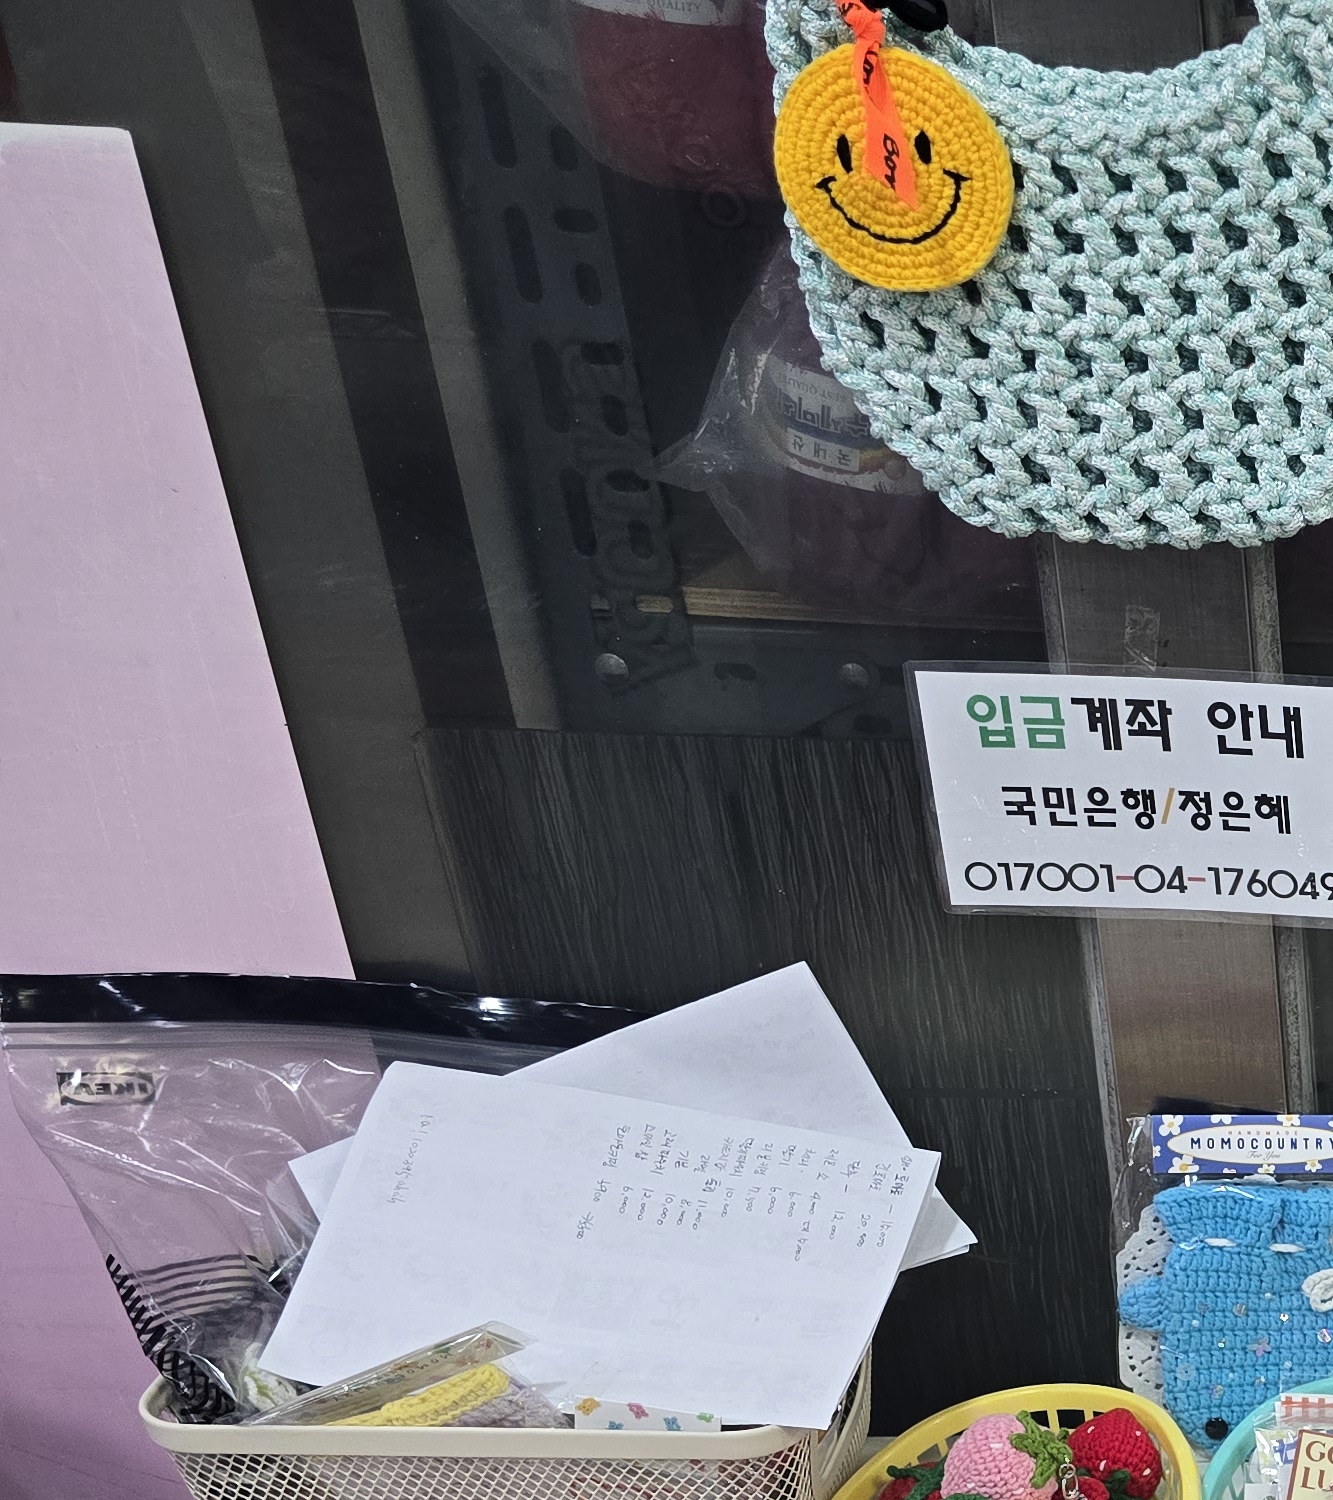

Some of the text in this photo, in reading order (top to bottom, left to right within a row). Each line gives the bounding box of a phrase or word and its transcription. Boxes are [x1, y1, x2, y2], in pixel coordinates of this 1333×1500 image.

[966, 693, 1304, 759] 입금계좌 안내
[1001, 786, 1292, 835] 국민은행/정은혜
